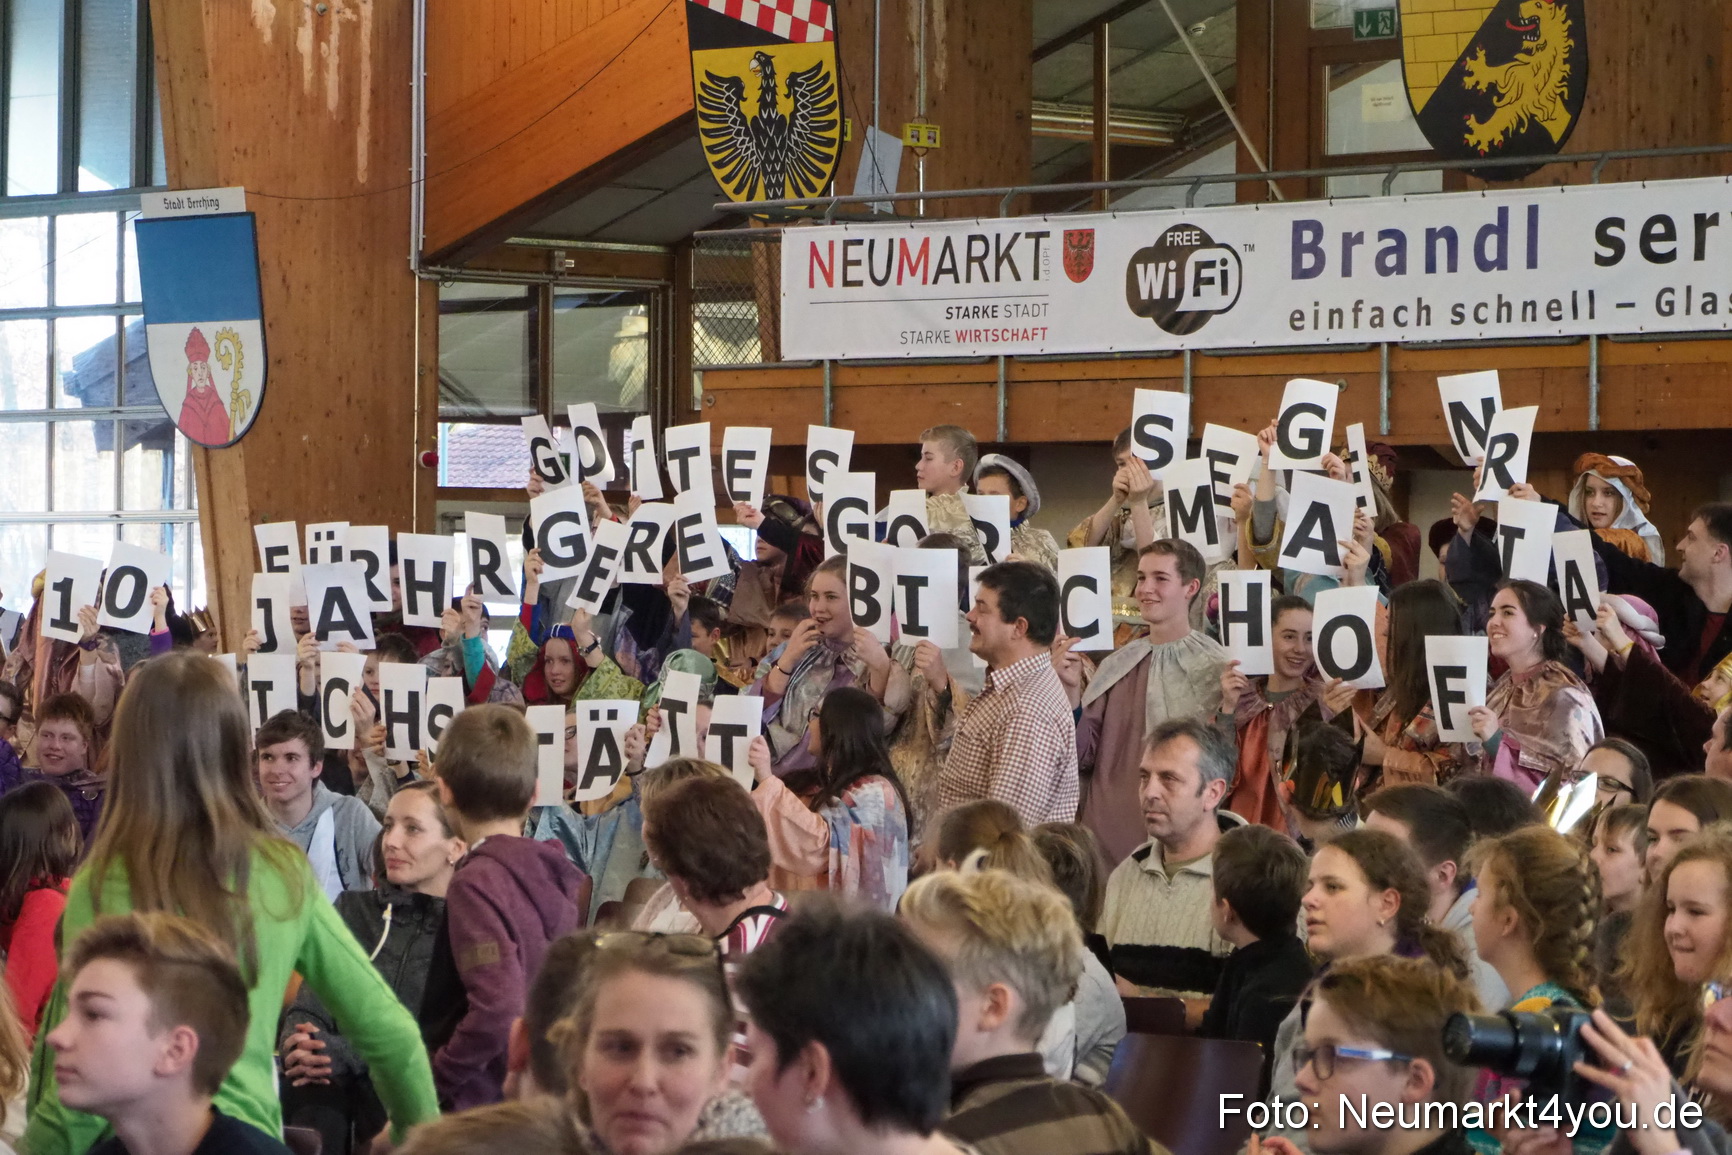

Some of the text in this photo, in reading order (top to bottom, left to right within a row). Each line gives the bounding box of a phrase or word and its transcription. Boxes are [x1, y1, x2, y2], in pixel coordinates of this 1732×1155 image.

[163, 197, 185, 210] Stadt
[1166, 231, 1201, 246] FREE
[1290, 203, 1732, 281] Brandl ser
[1243, 243, 1255, 252] TM
[808, 231, 1051, 289] NEUMARKT
[945, 303, 1049, 320] STARKE STADT
[1289, 297, 1433, 332] einfach
[1450, 289, 1596, 326] schnell
[1655, 285, 1732, 317] Gla
[900, 327, 1049, 345] STARKE WIRTSCHAFT
